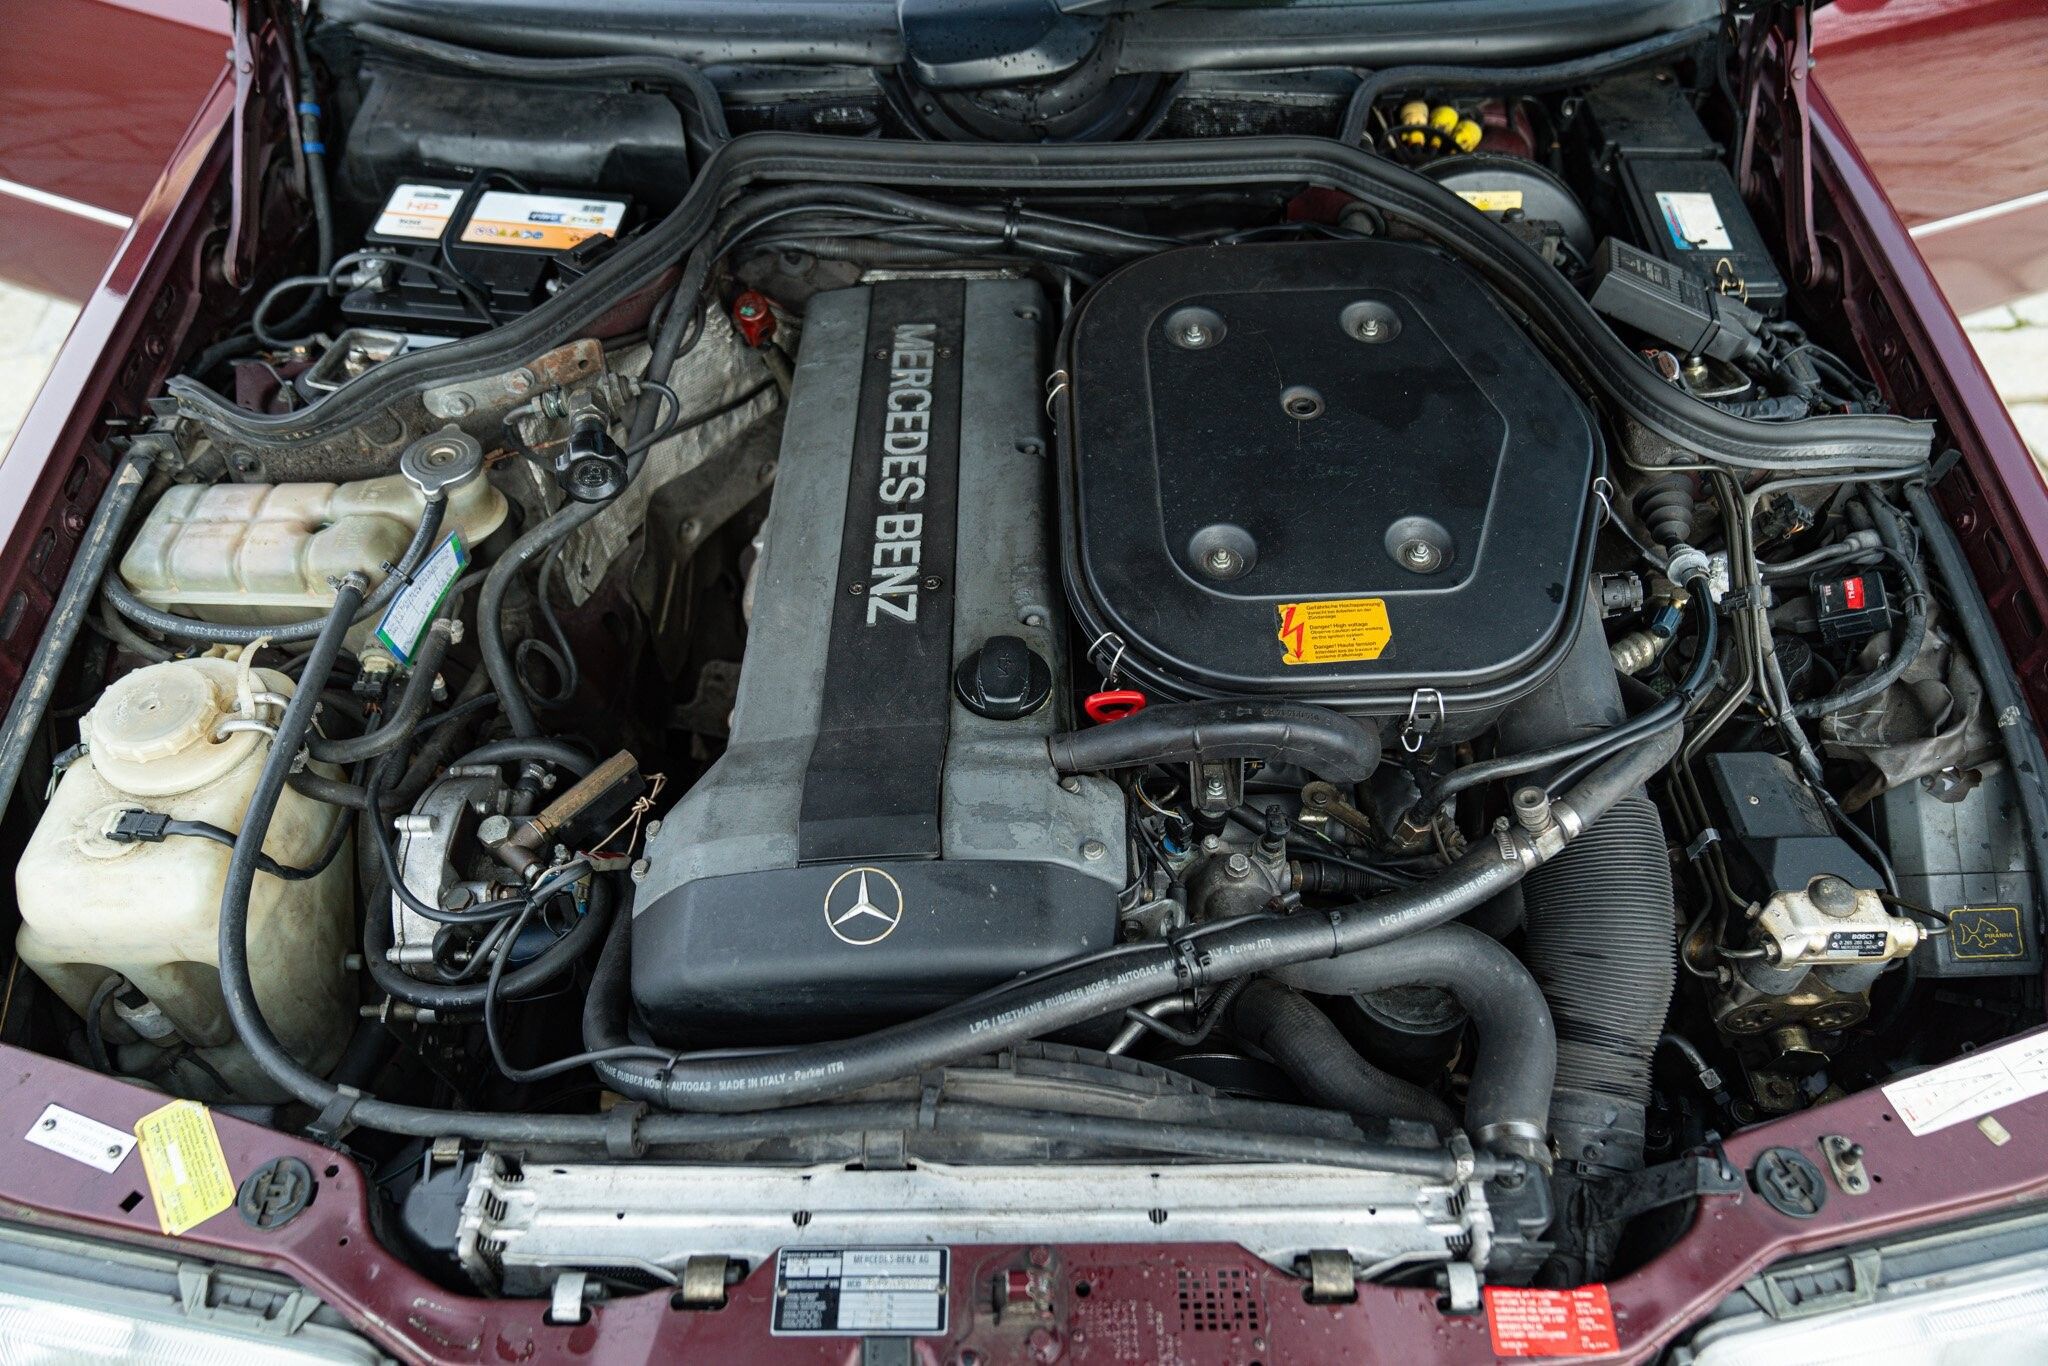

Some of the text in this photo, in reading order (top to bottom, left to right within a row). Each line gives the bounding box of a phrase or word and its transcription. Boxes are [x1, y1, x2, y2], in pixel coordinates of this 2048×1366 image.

[1403, 898, 1445, 921] METHANE
[1445, 883, 1476, 903] RUBBER
[1477, 868, 1498, 886] HOSE
[1228, 942, 1256, 955] Parker
[969, 965, 1157, 1034] LPG METHANE RUBBER HOSE AUTOGAS
[617, 1070, 643, 1087] RUBBER
[671, 1081, 711, 1092] AUTOGAS
[718, 1079, 745, 1091] MADE
[747, 1077, 758, 1089] IN
[760, 1073, 786, 1087] ITALY
[794, 1067, 824, 1081] Parker
[827, 1061, 844, 1074] ITR
